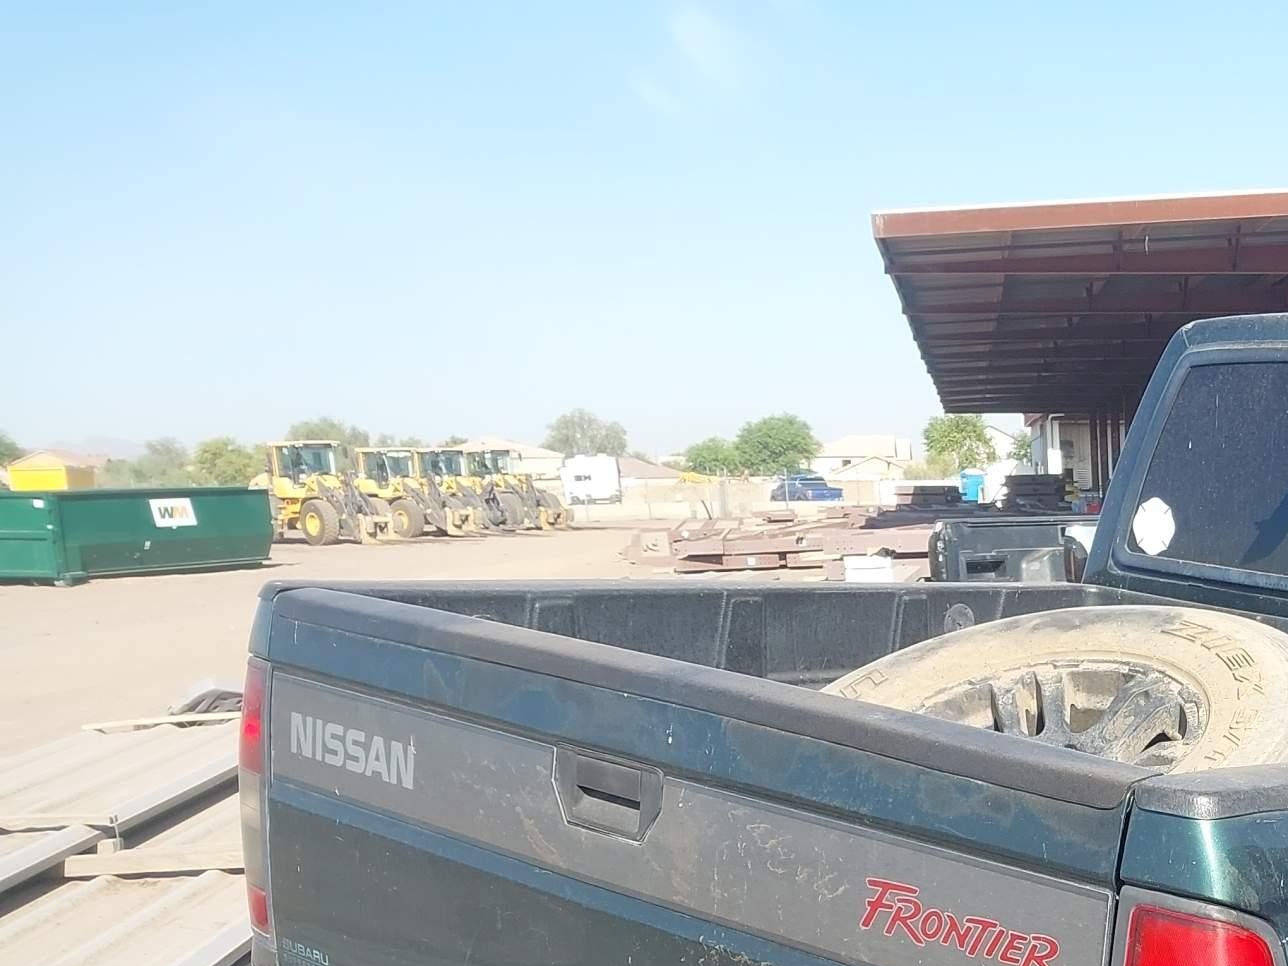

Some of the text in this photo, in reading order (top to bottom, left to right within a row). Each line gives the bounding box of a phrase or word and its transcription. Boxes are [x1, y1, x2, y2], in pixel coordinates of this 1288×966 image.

[158, 505, 190, 520] WM
[290, 711, 415, 791] NISSAN
[282, 937, 329, 966] SUBARU
